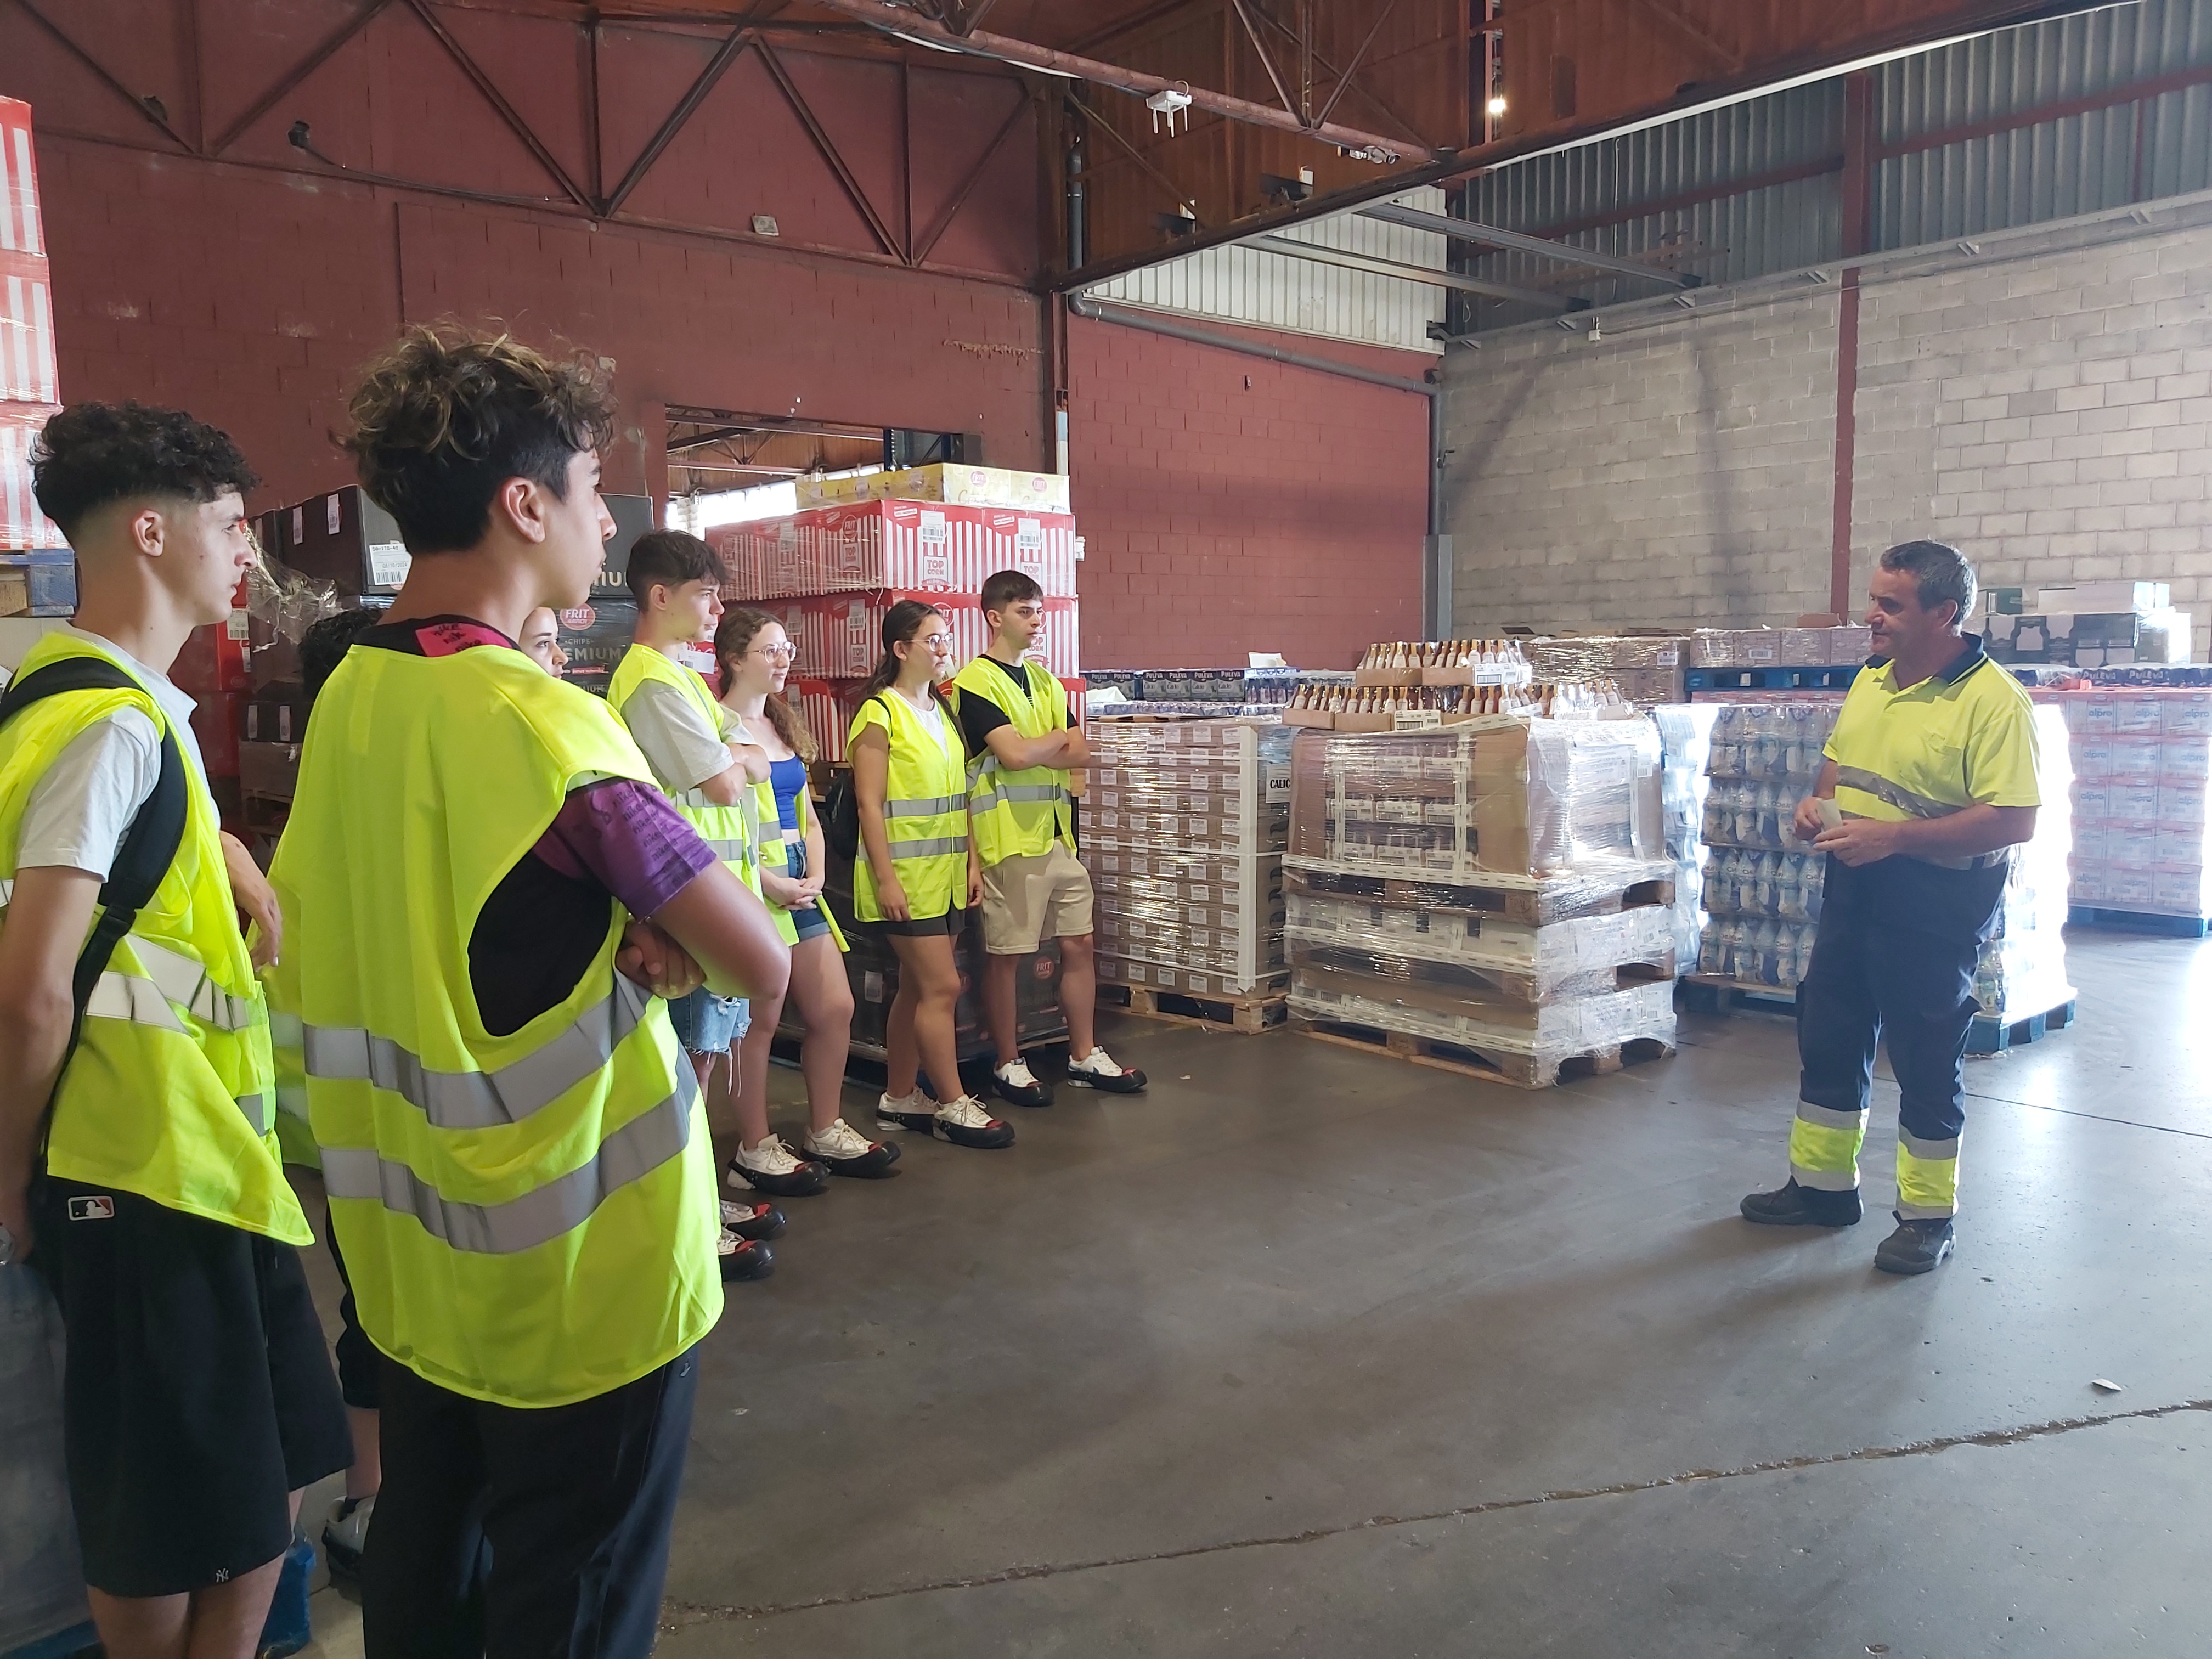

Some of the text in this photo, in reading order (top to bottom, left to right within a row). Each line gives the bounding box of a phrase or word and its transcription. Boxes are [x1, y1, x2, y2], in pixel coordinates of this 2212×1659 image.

[845, 547, 856, 556] TOP
[927, 560, 944, 568] TOP
[1024, 566, 1039, 574] TOP
[566, 608, 590, 618] FRIT
[563, 647, 622, 662] EMIUM
[853, 647, 864, 656] TOP
[2129, 670, 2164, 679] PULEVA
[2089, 708, 2112, 718] alpro
[2136, 709, 2159, 718] alpro
[2185, 709, 2209, 718] alpro
[2084, 749, 2107, 759] alpro
[2181, 753, 2205, 762] alpro
[2081, 792, 2104, 802] alpro
[1036, 962, 1051, 972] FRIT
